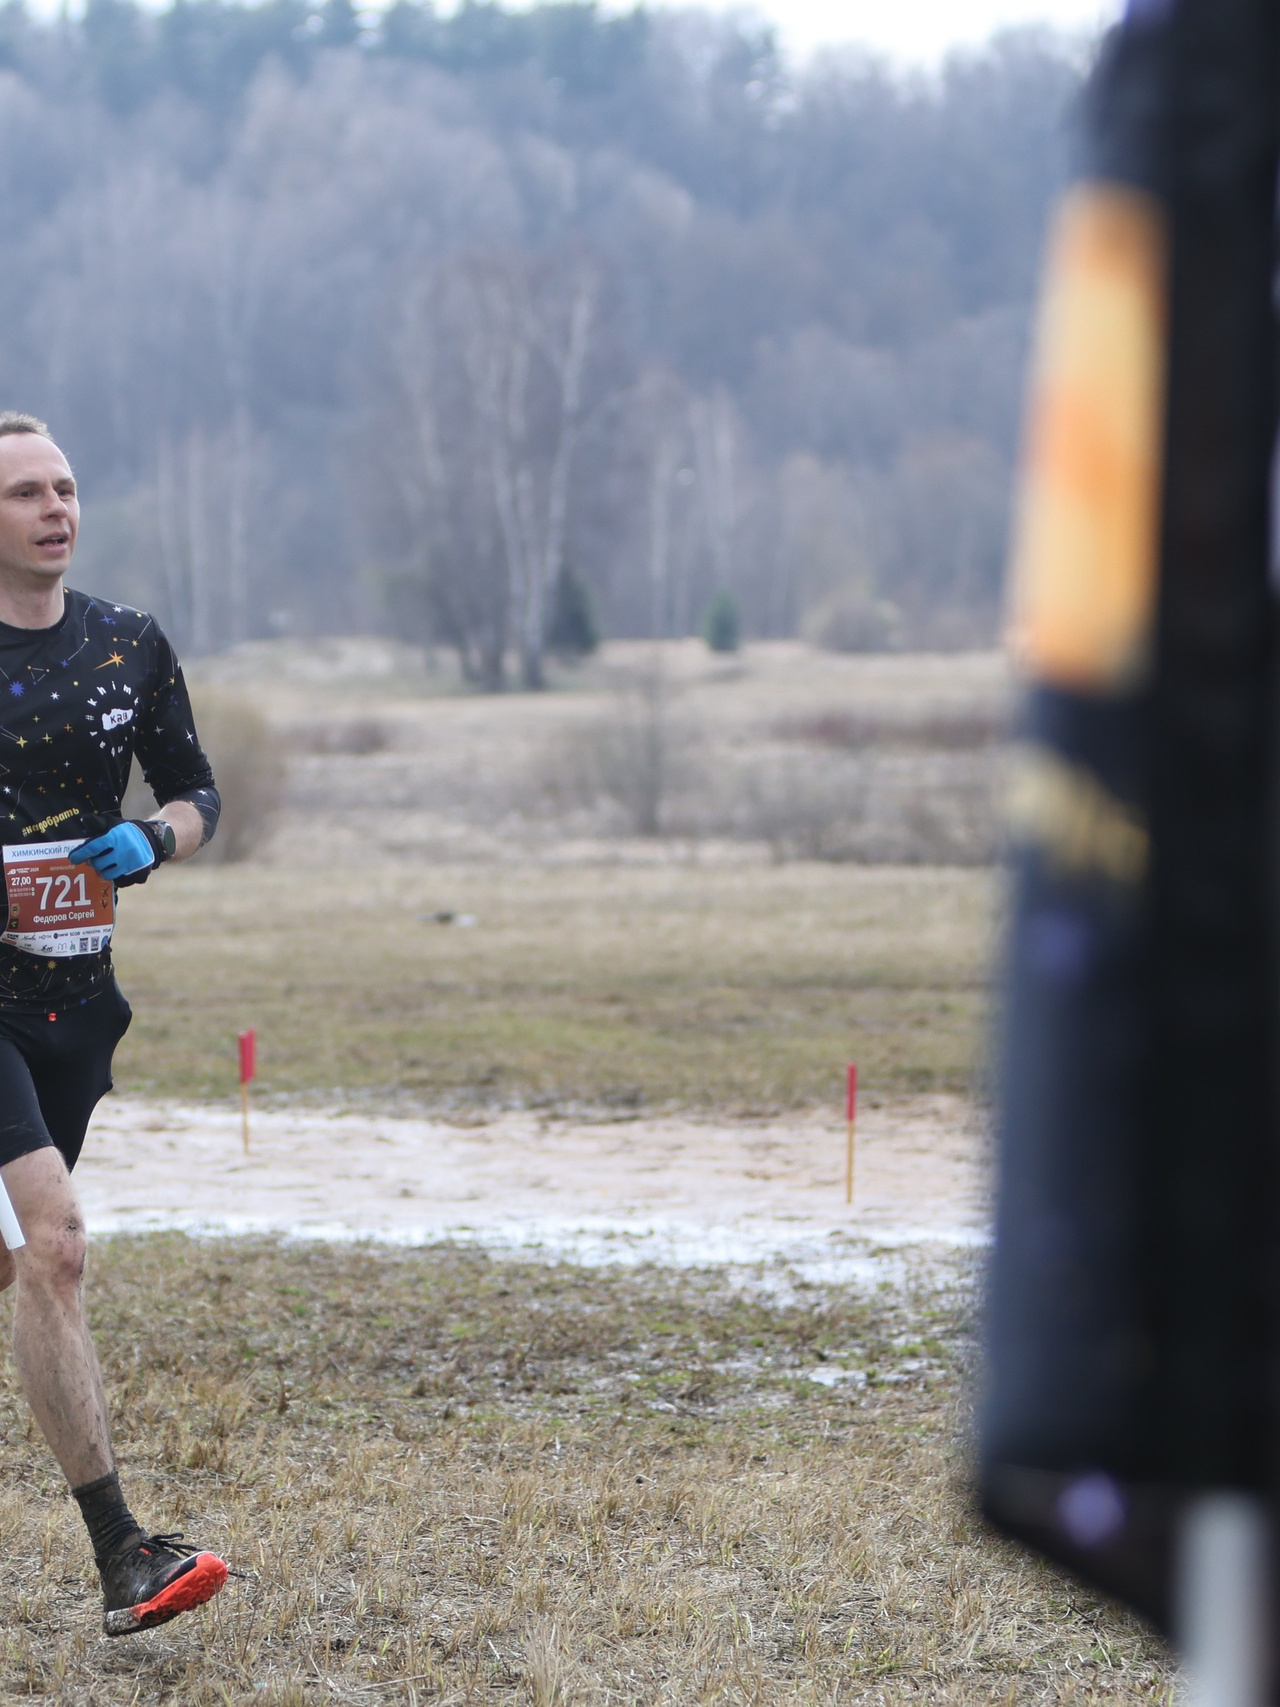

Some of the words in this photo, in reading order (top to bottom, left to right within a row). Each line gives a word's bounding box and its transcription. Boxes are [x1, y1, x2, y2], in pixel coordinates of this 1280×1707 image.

[110, 712, 128, 724] KRB
[11, 846, 62, 858] ХИМКИНСКИЙ
[11, 876, 31, 887] 27,00
[35, 873, 92, 910] 721
[33, 913, 67, 924] Федоров
[68, 909, 95, 921] Сергей
